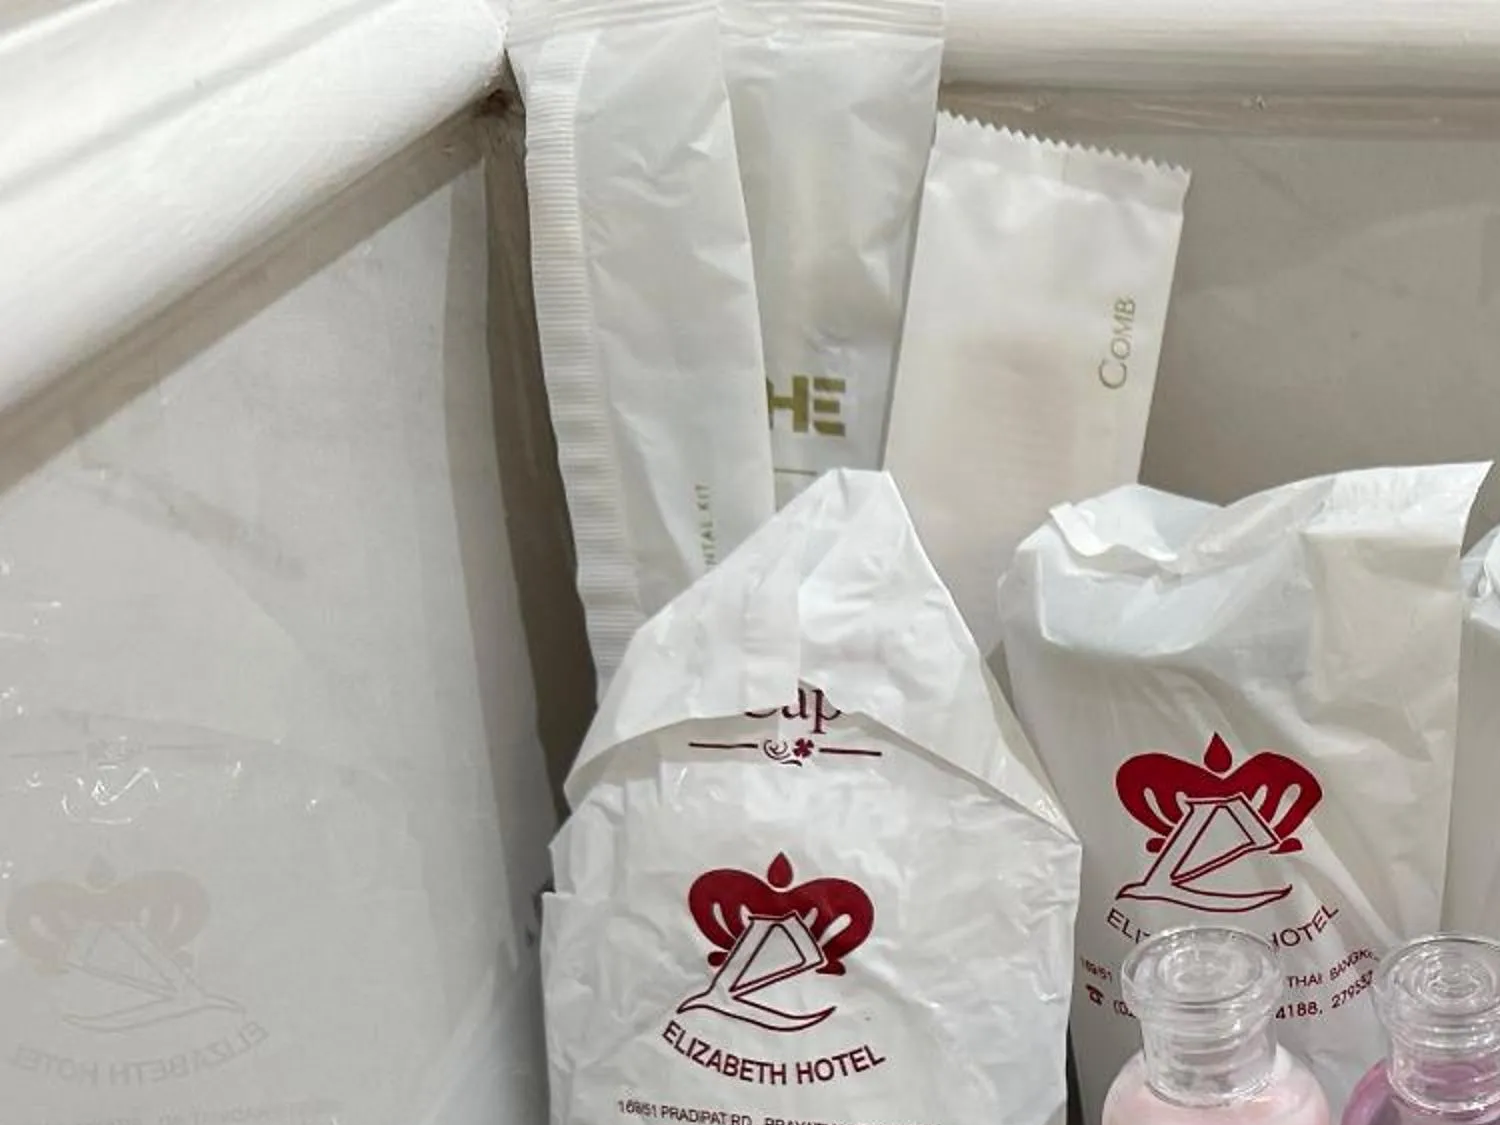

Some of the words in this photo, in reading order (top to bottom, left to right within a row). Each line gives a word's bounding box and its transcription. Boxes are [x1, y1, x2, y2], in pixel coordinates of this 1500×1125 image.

[1275, 1001, 1324, 1020] 4188,
[661, 1019, 787, 1085] ELIZABETH
[796, 1044, 886, 1085] HOTEL
